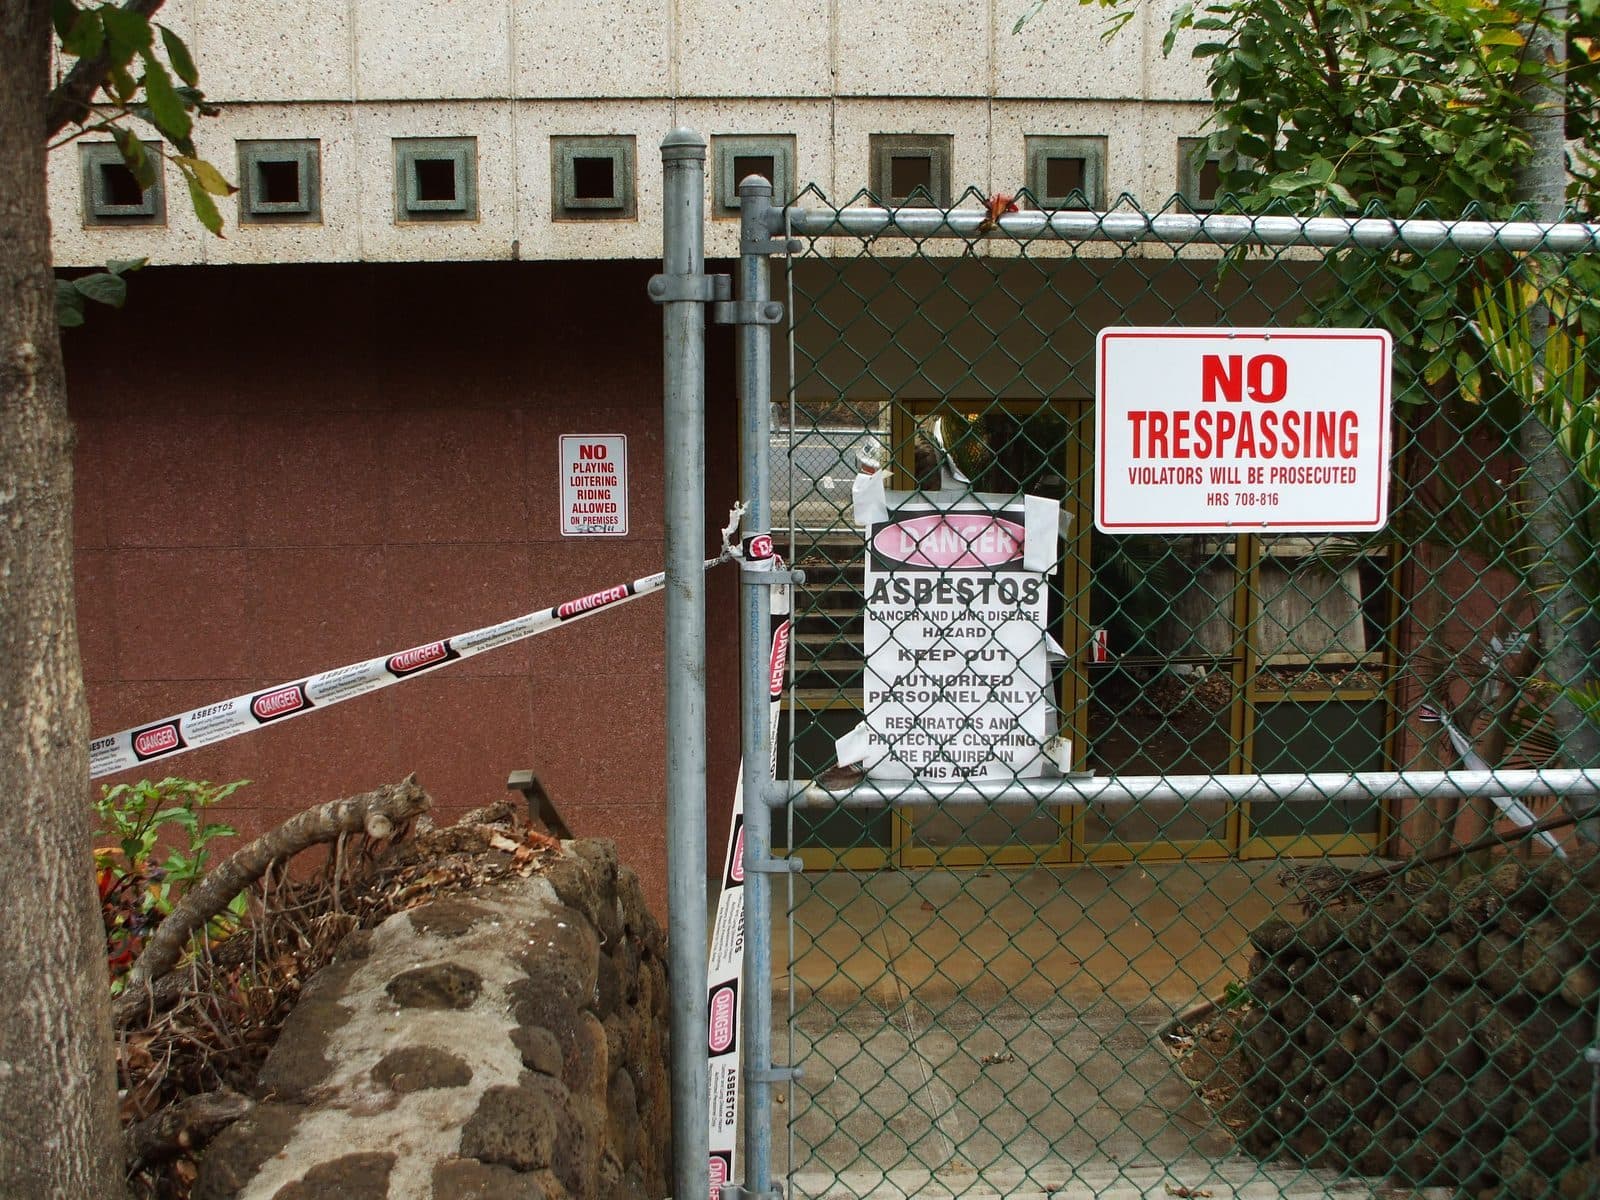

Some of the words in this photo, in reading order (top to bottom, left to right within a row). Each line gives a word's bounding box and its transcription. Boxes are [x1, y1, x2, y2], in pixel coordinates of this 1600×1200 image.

[1202, 354, 1287, 403] NO
[1128, 410, 1359, 459] TRESPASSING
[580, 444, 607, 460] NO
[573, 463, 614, 473] PLAYING
[570, 476, 617, 487] LOITERING
[1129, 467, 1203, 485] VIOLATORS
[1210, 467, 1241, 484] WILL
[1248, 466, 1264, 484] BE
[1270, 466, 1357, 484] PROSECUTED
[577, 489, 611, 500] RIDING
[1207, 493, 1229, 506] HRS
[1235, 493, 1279, 506] 708-816
[572, 503, 617, 513] ALLOWED
[570, 517, 580, 525] ON
[583, 516, 618, 525] PREMISES
[900, 526, 1014, 553] DANGER
[870, 577, 1040, 605] ASBESTOS
[869, 610, 920, 621] CANCER
[923, 611, 948, 621] AND
[952, 611, 985, 621] LUNG
[988, 610, 1040, 621] DISEASE
[923, 627, 986, 638] HAZARD
[397, 645, 440, 669] DANGER
[898, 649, 956, 662] KEEP
[964, 649, 1009, 662] OUT
[893, 674, 1014, 687] AUTHORIZED
[258, 690, 298, 714] DANGER
[869, 691, 980, 703] PERSONNEL
[986, 690, 1037, 703] ONLY
[191, 702, 234, 721] ASBESTOS
[989, 718, 1018, 730] AND
[139, 729, 177, 752] DANGER
[869, 733, 957, 746] PROTECTIVE
[963, 734, 1036, 746] CLOTHING
[889, 750, 917, 762] ARE
[923, 750, 995, 762] REQUIRED
[1000, 750, 1013, 762] IN
[914, 767, 947, 778] THIS
[714, 993, 730, 1047] DANGER
[725, 1068, 736, 1126] ASBESTOS
